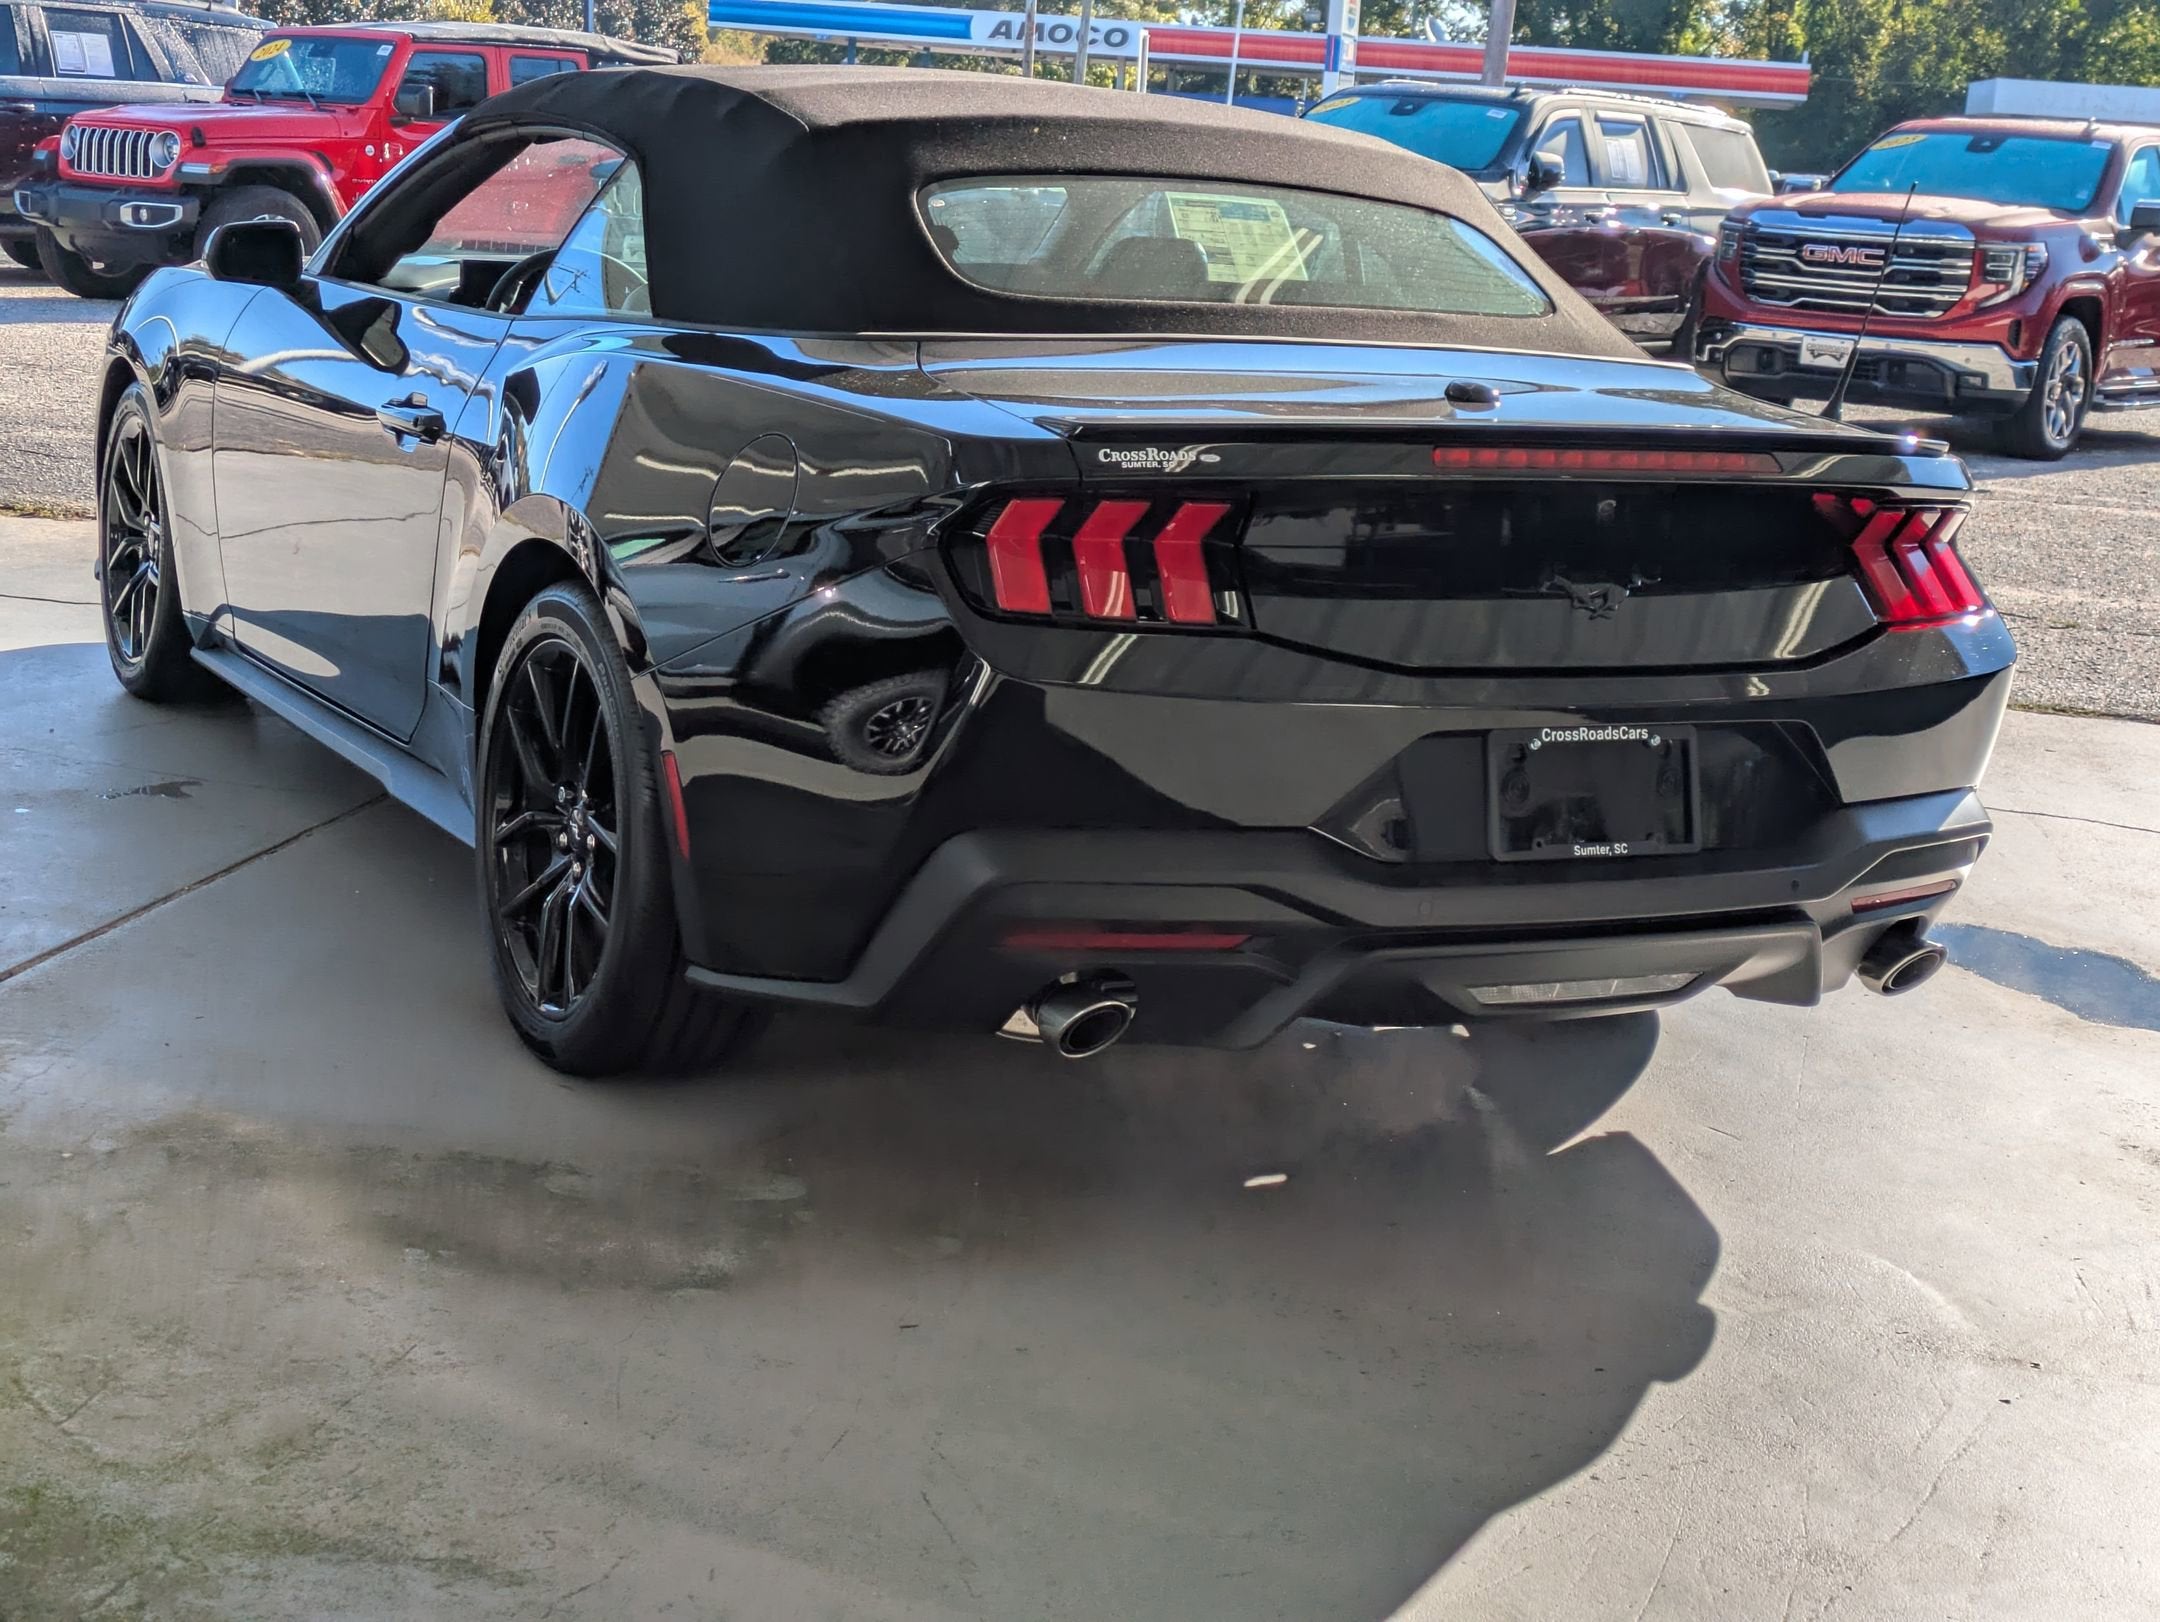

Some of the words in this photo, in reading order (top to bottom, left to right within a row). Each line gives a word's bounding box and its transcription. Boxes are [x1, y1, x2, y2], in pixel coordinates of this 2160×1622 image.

[987, 20, 1130, 48] AMOCO
[1802, 243, 1885, 266] GMC
[1541, 726, 1649, 742] CrossRoadsCars
[1574, 845, 1612, 857] Sumter,
[1614, 843, 1628, 854] SC
